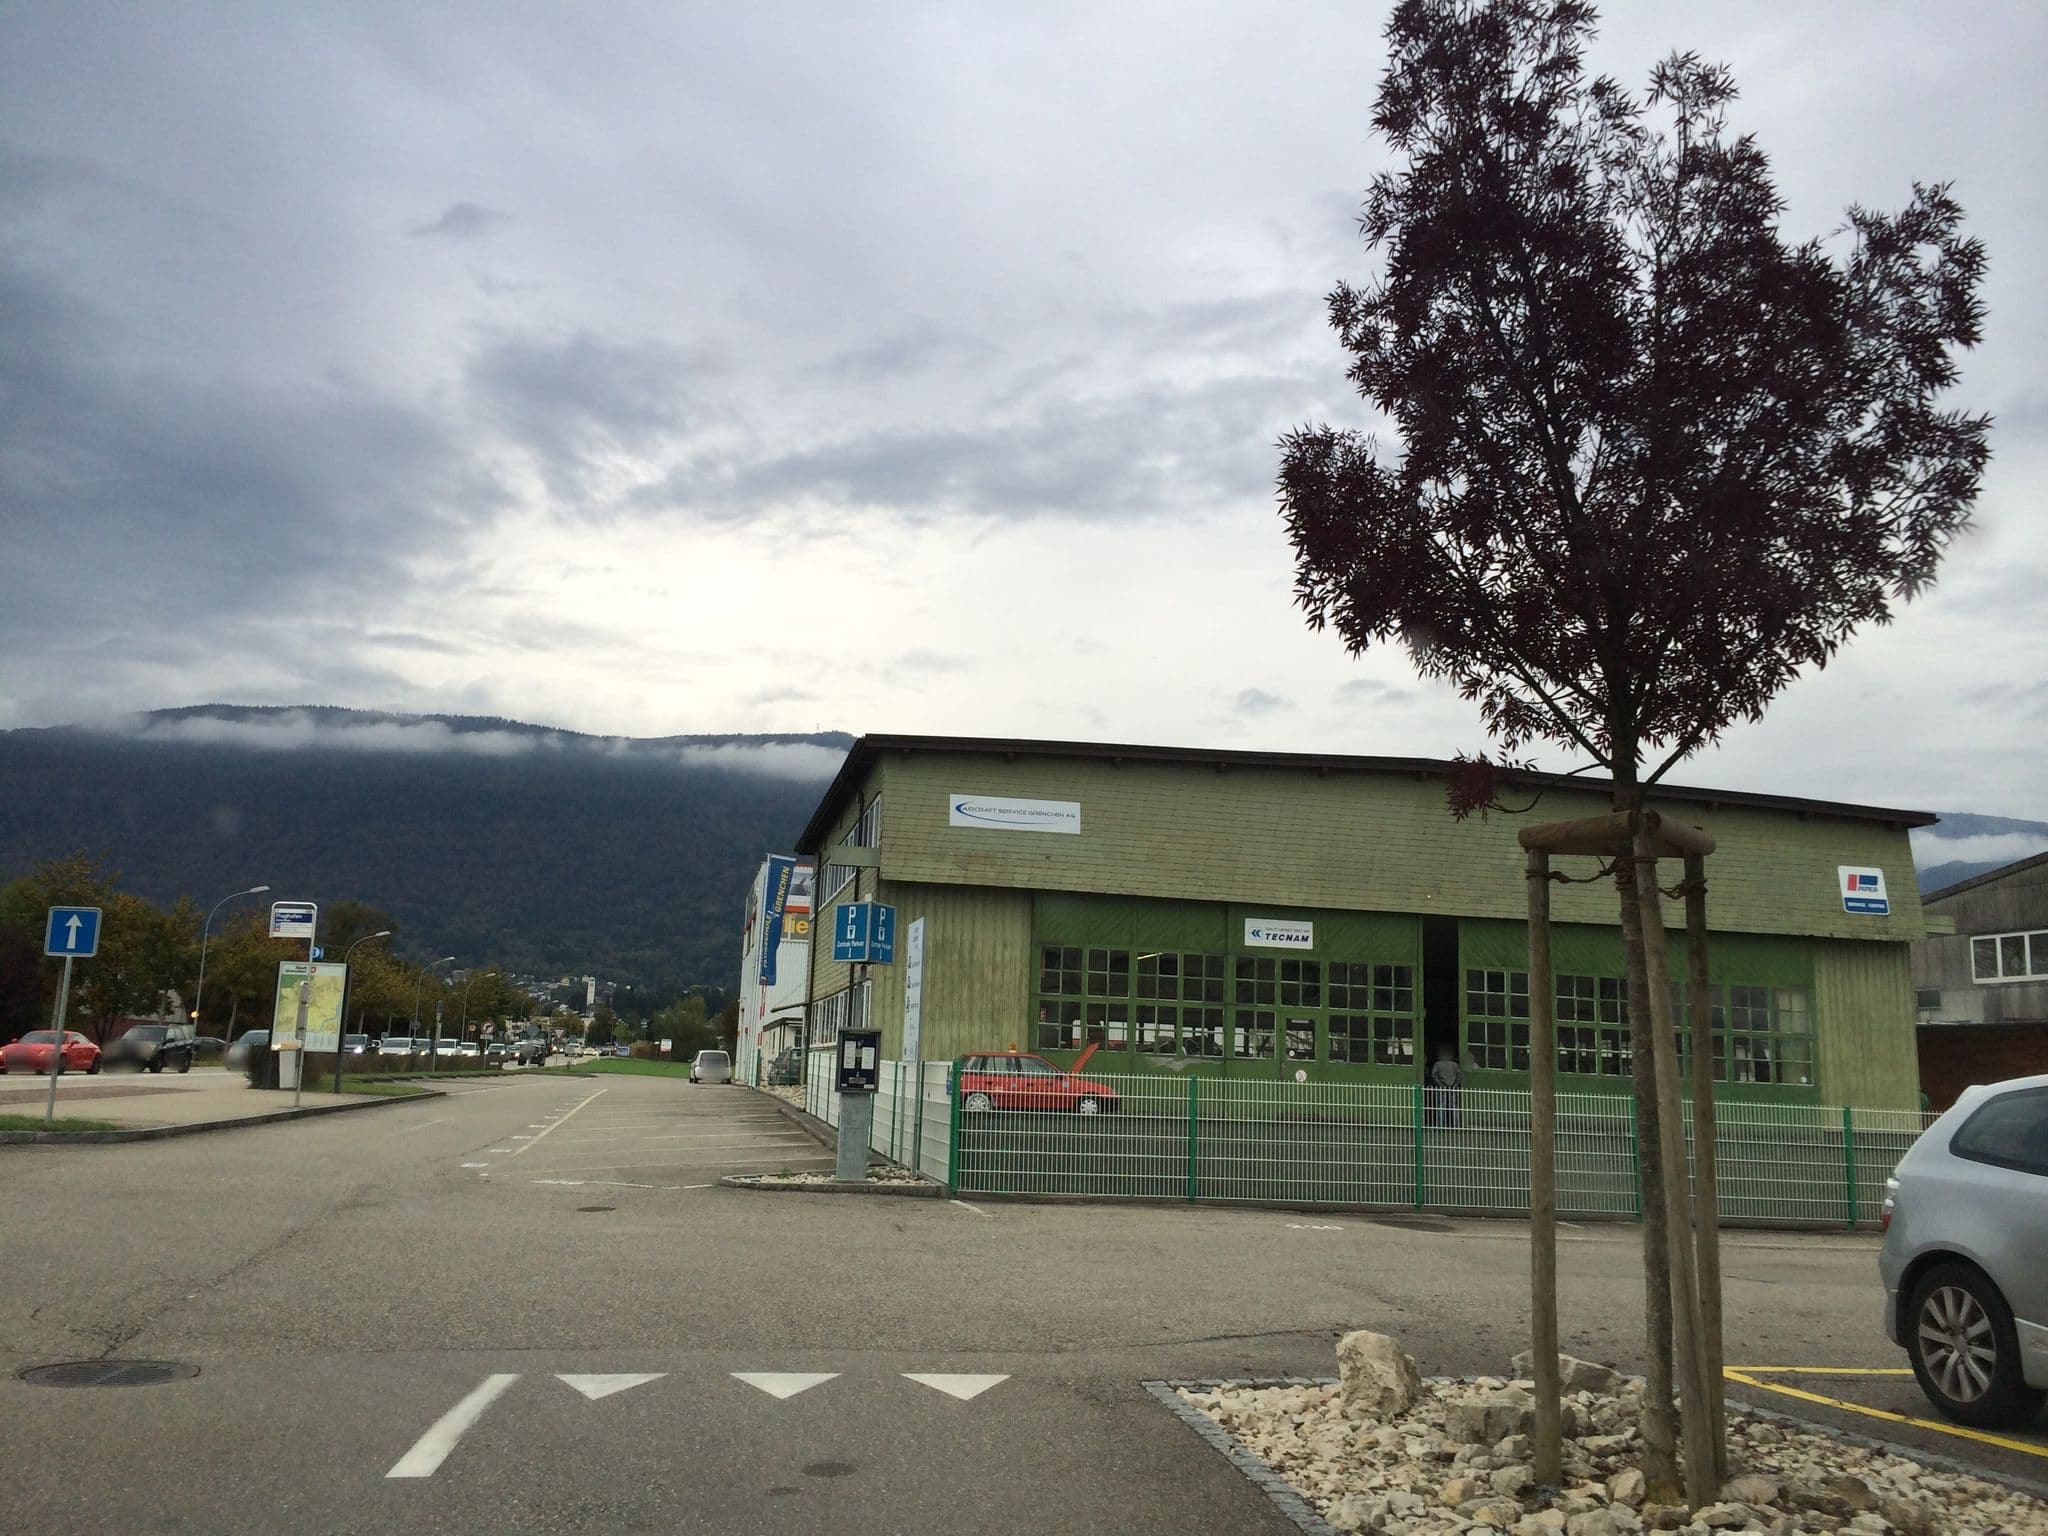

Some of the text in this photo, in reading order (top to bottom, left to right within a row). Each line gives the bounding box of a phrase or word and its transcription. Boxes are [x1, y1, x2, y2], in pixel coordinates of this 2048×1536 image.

[963, 806, 996, 814] AIRCRAFT
[1028, 810, 1064, 818] GRENCHEN
[775, 866, 790, 913] GRENCHEN
[848, 906, 857, 924] P
[880, 908, 886, 925] P
[1265, 933, 1309, 942] TECNAM
